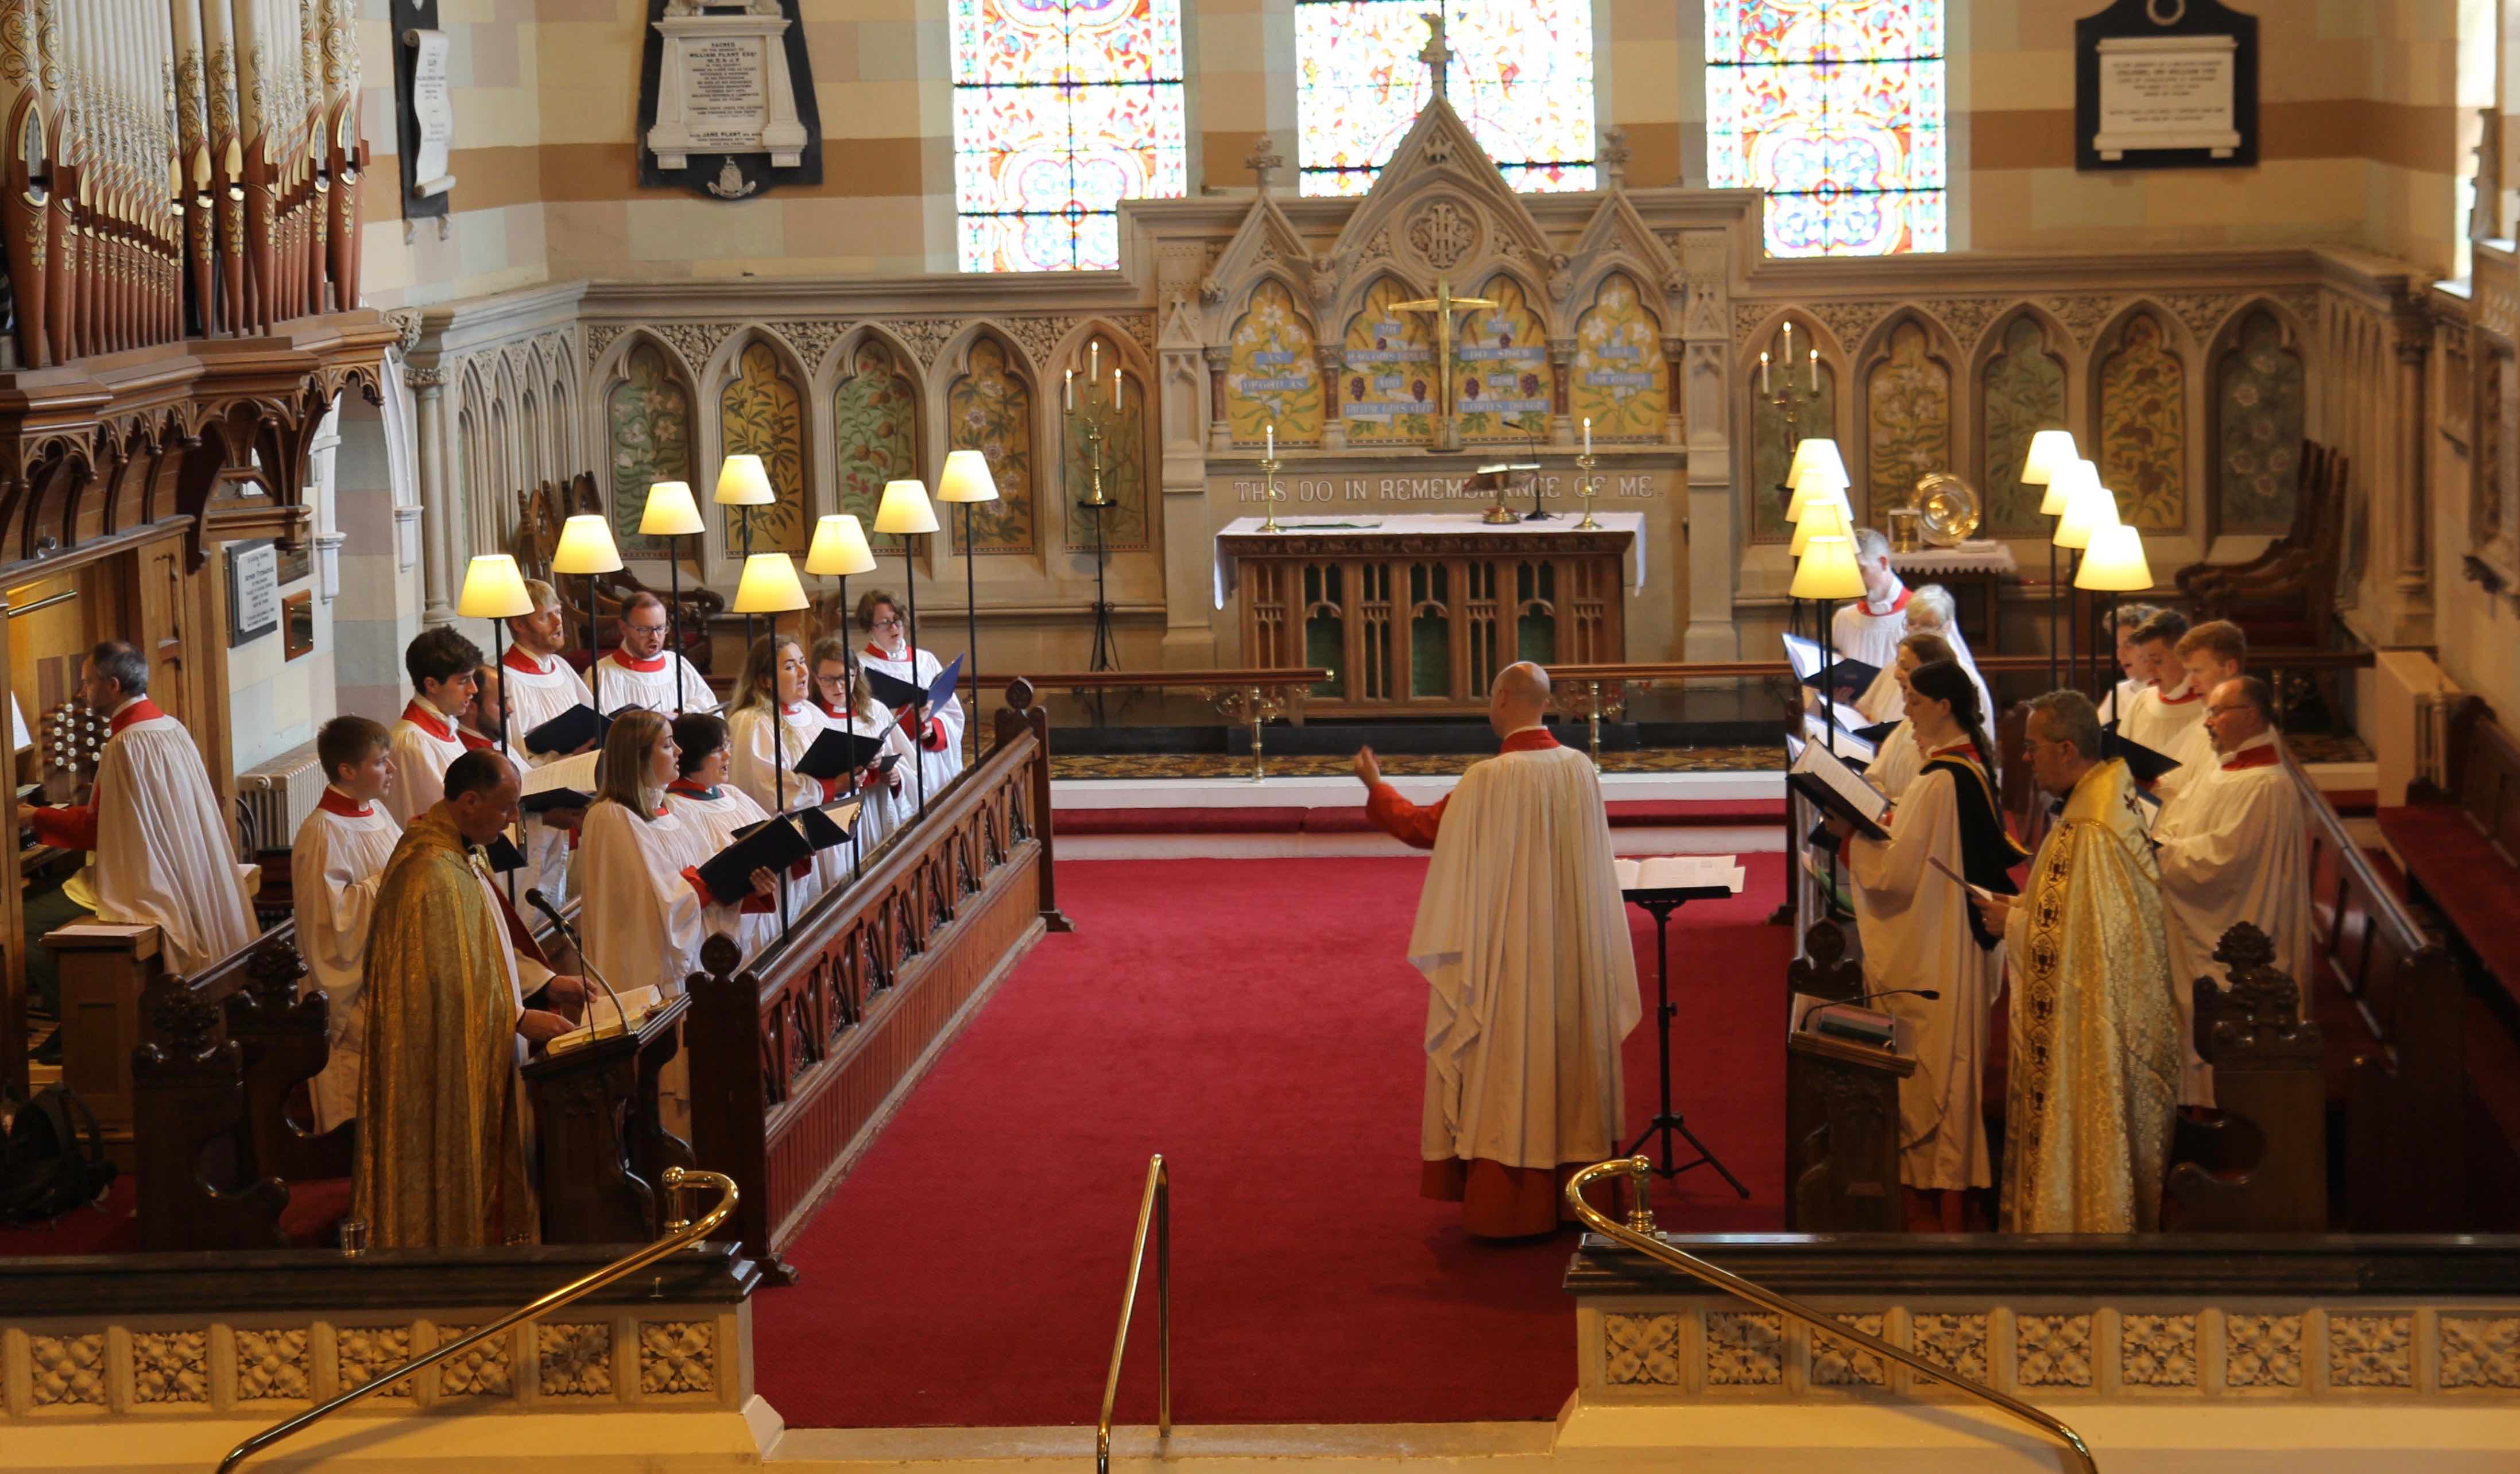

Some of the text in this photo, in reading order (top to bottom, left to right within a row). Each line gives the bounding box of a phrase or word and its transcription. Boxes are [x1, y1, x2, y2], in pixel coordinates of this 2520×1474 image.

[1234, 480, 1287, 503] THS
[1299, 480, 1333, 502] DO
[1345, 479, 1368, 501] IN
[1379, 476, 1561, 501] REMEMNCE
[1573, 476, 1607, 498] OF
